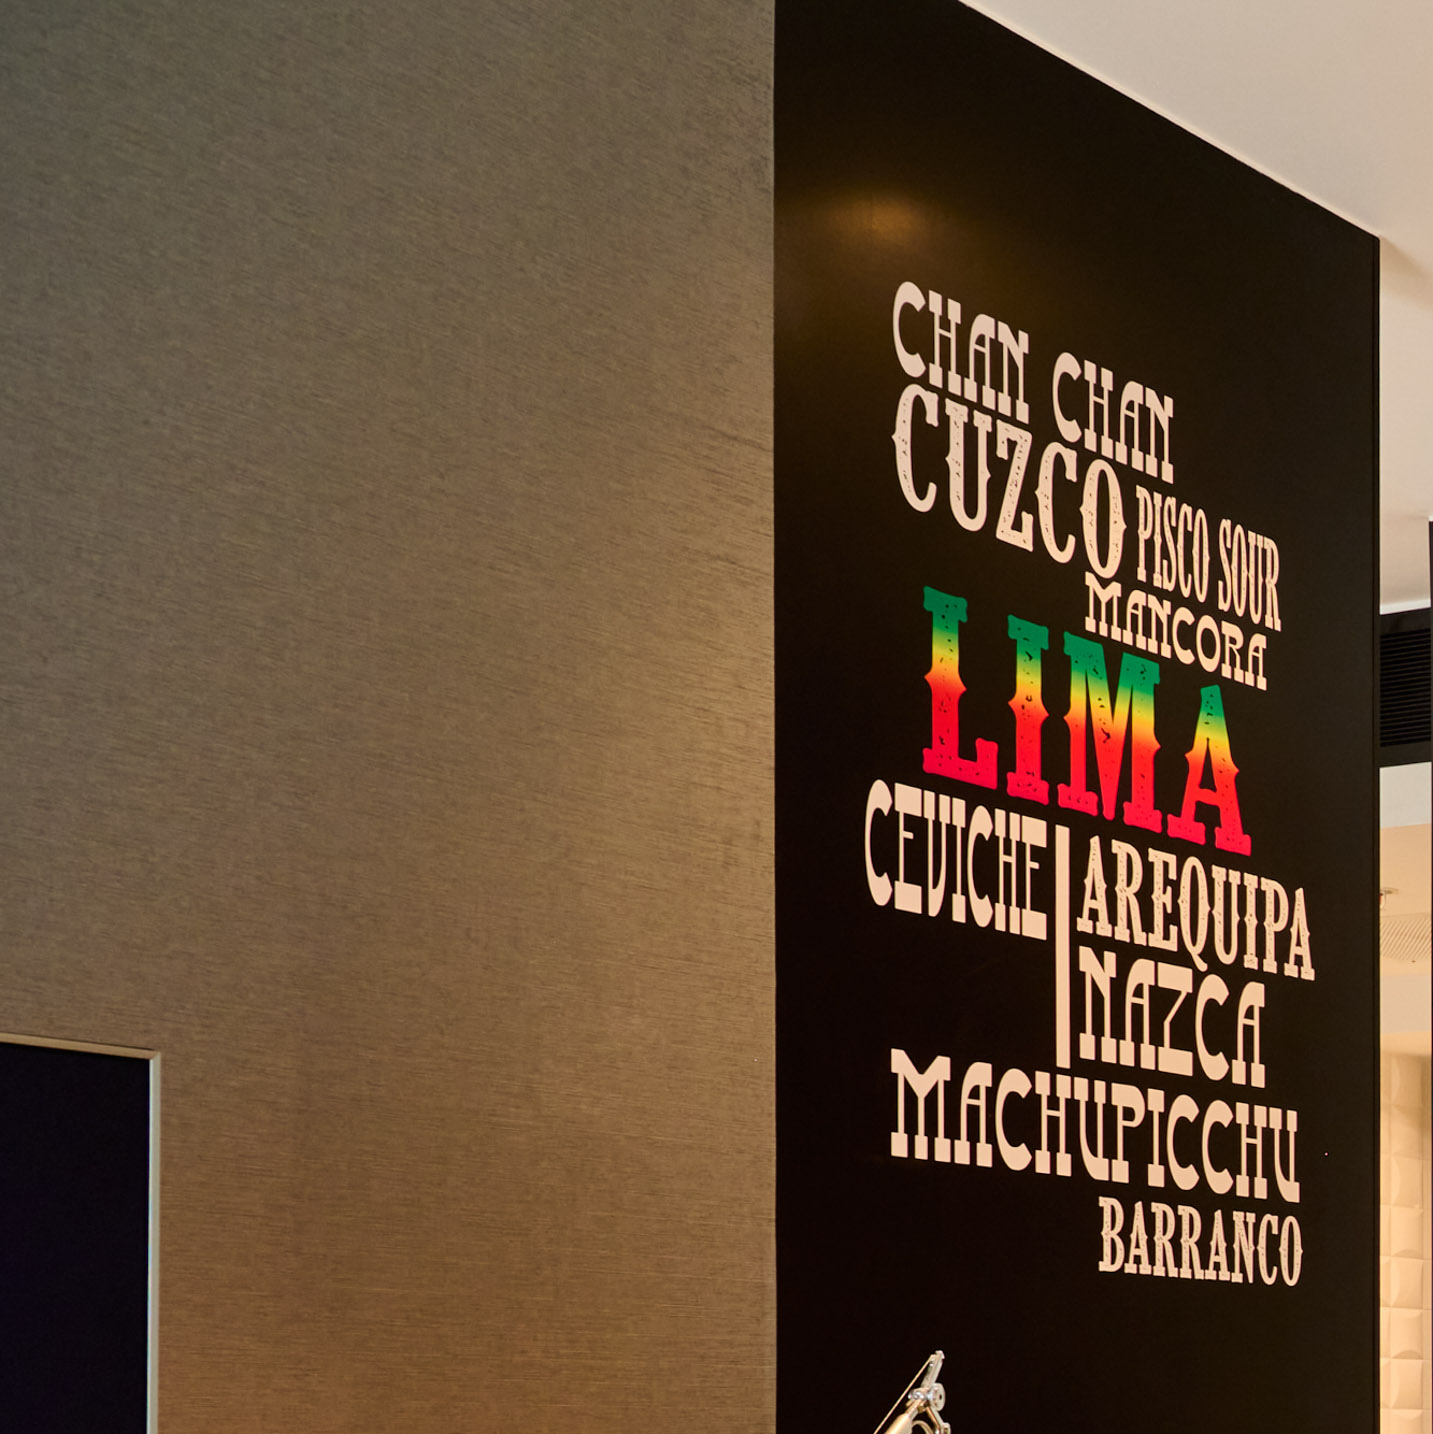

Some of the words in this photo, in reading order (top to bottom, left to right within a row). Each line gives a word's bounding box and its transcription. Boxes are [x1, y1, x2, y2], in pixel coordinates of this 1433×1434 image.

[892, 281, 1029, 424] CHAN
[1052, 352, 1174, 484] CHAN
[891, 383, 1127, 578] CUZCO
[1084, 571, 1267, 691] MANCORA
[1136, 484, 1210, 602] PISCO
[1218, 518, 1282, 631] SOUR
[922, 585, 1251, 856] LIMA
[864, 779, 1047, 940] CEVICHE
[1076, 835, 1315, 980] AREQUIPA
[1078, 945, 1265, 1088] NAZCA
[890, 1048, 1300, 1203] MACHUPICCHU
[1098, 1196, 1303, 1287] BARRANCO
